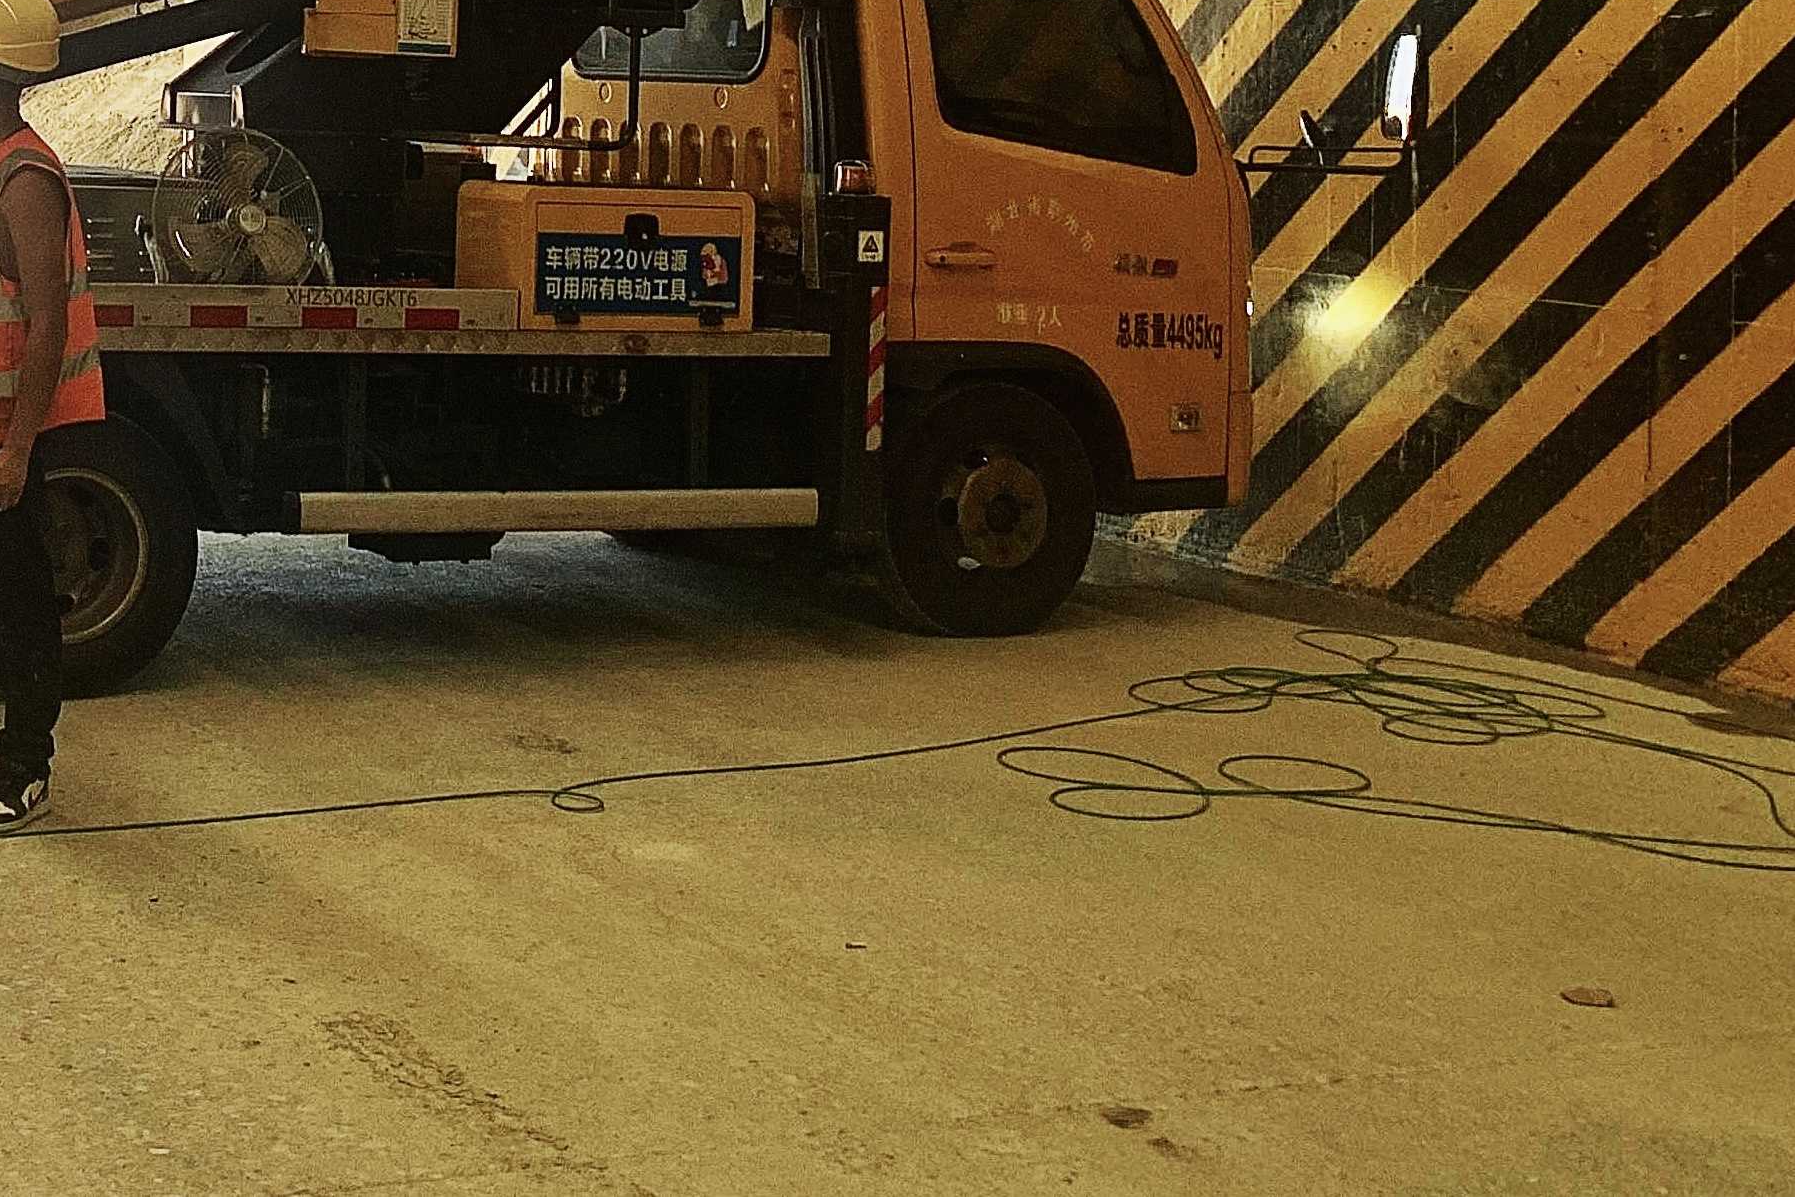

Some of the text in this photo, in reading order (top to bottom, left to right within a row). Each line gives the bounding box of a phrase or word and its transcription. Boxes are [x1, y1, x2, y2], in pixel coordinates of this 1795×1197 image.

[545, 245, 689, 273] 车辆带220V电源
[285, 287, 418, 307] XHZ5048JGKT6
[544, 276, 687, 302] 可用所有电动工具
[1116, 311, 1224, 360] 总质量4495kg
